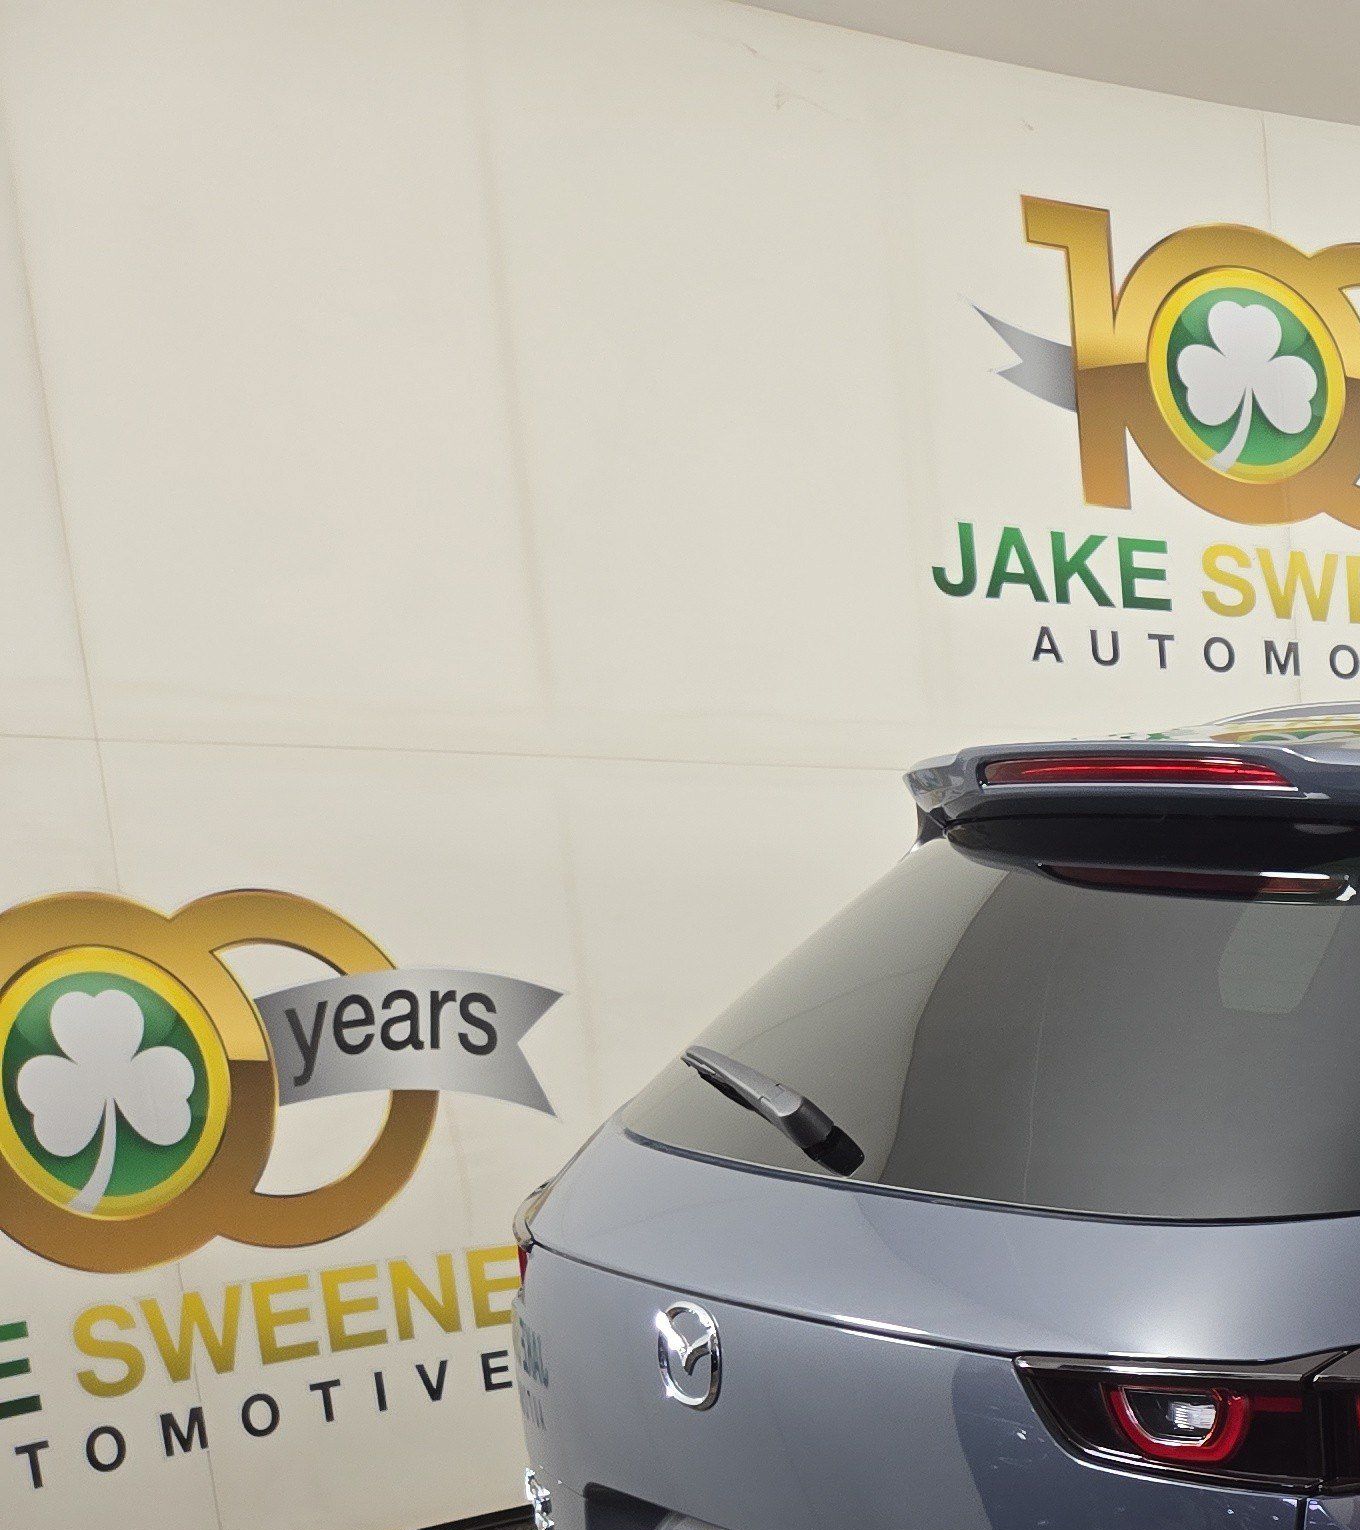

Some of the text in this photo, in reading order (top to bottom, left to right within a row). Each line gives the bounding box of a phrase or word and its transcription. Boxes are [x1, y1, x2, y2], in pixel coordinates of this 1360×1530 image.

[931, 522, 1173, 613] JAKE
[284, 990, 498, 1087] years
[71, 1243, 525, 1399] SWEENE
[14, 1350, 514, 1490] TOMOTIVE
